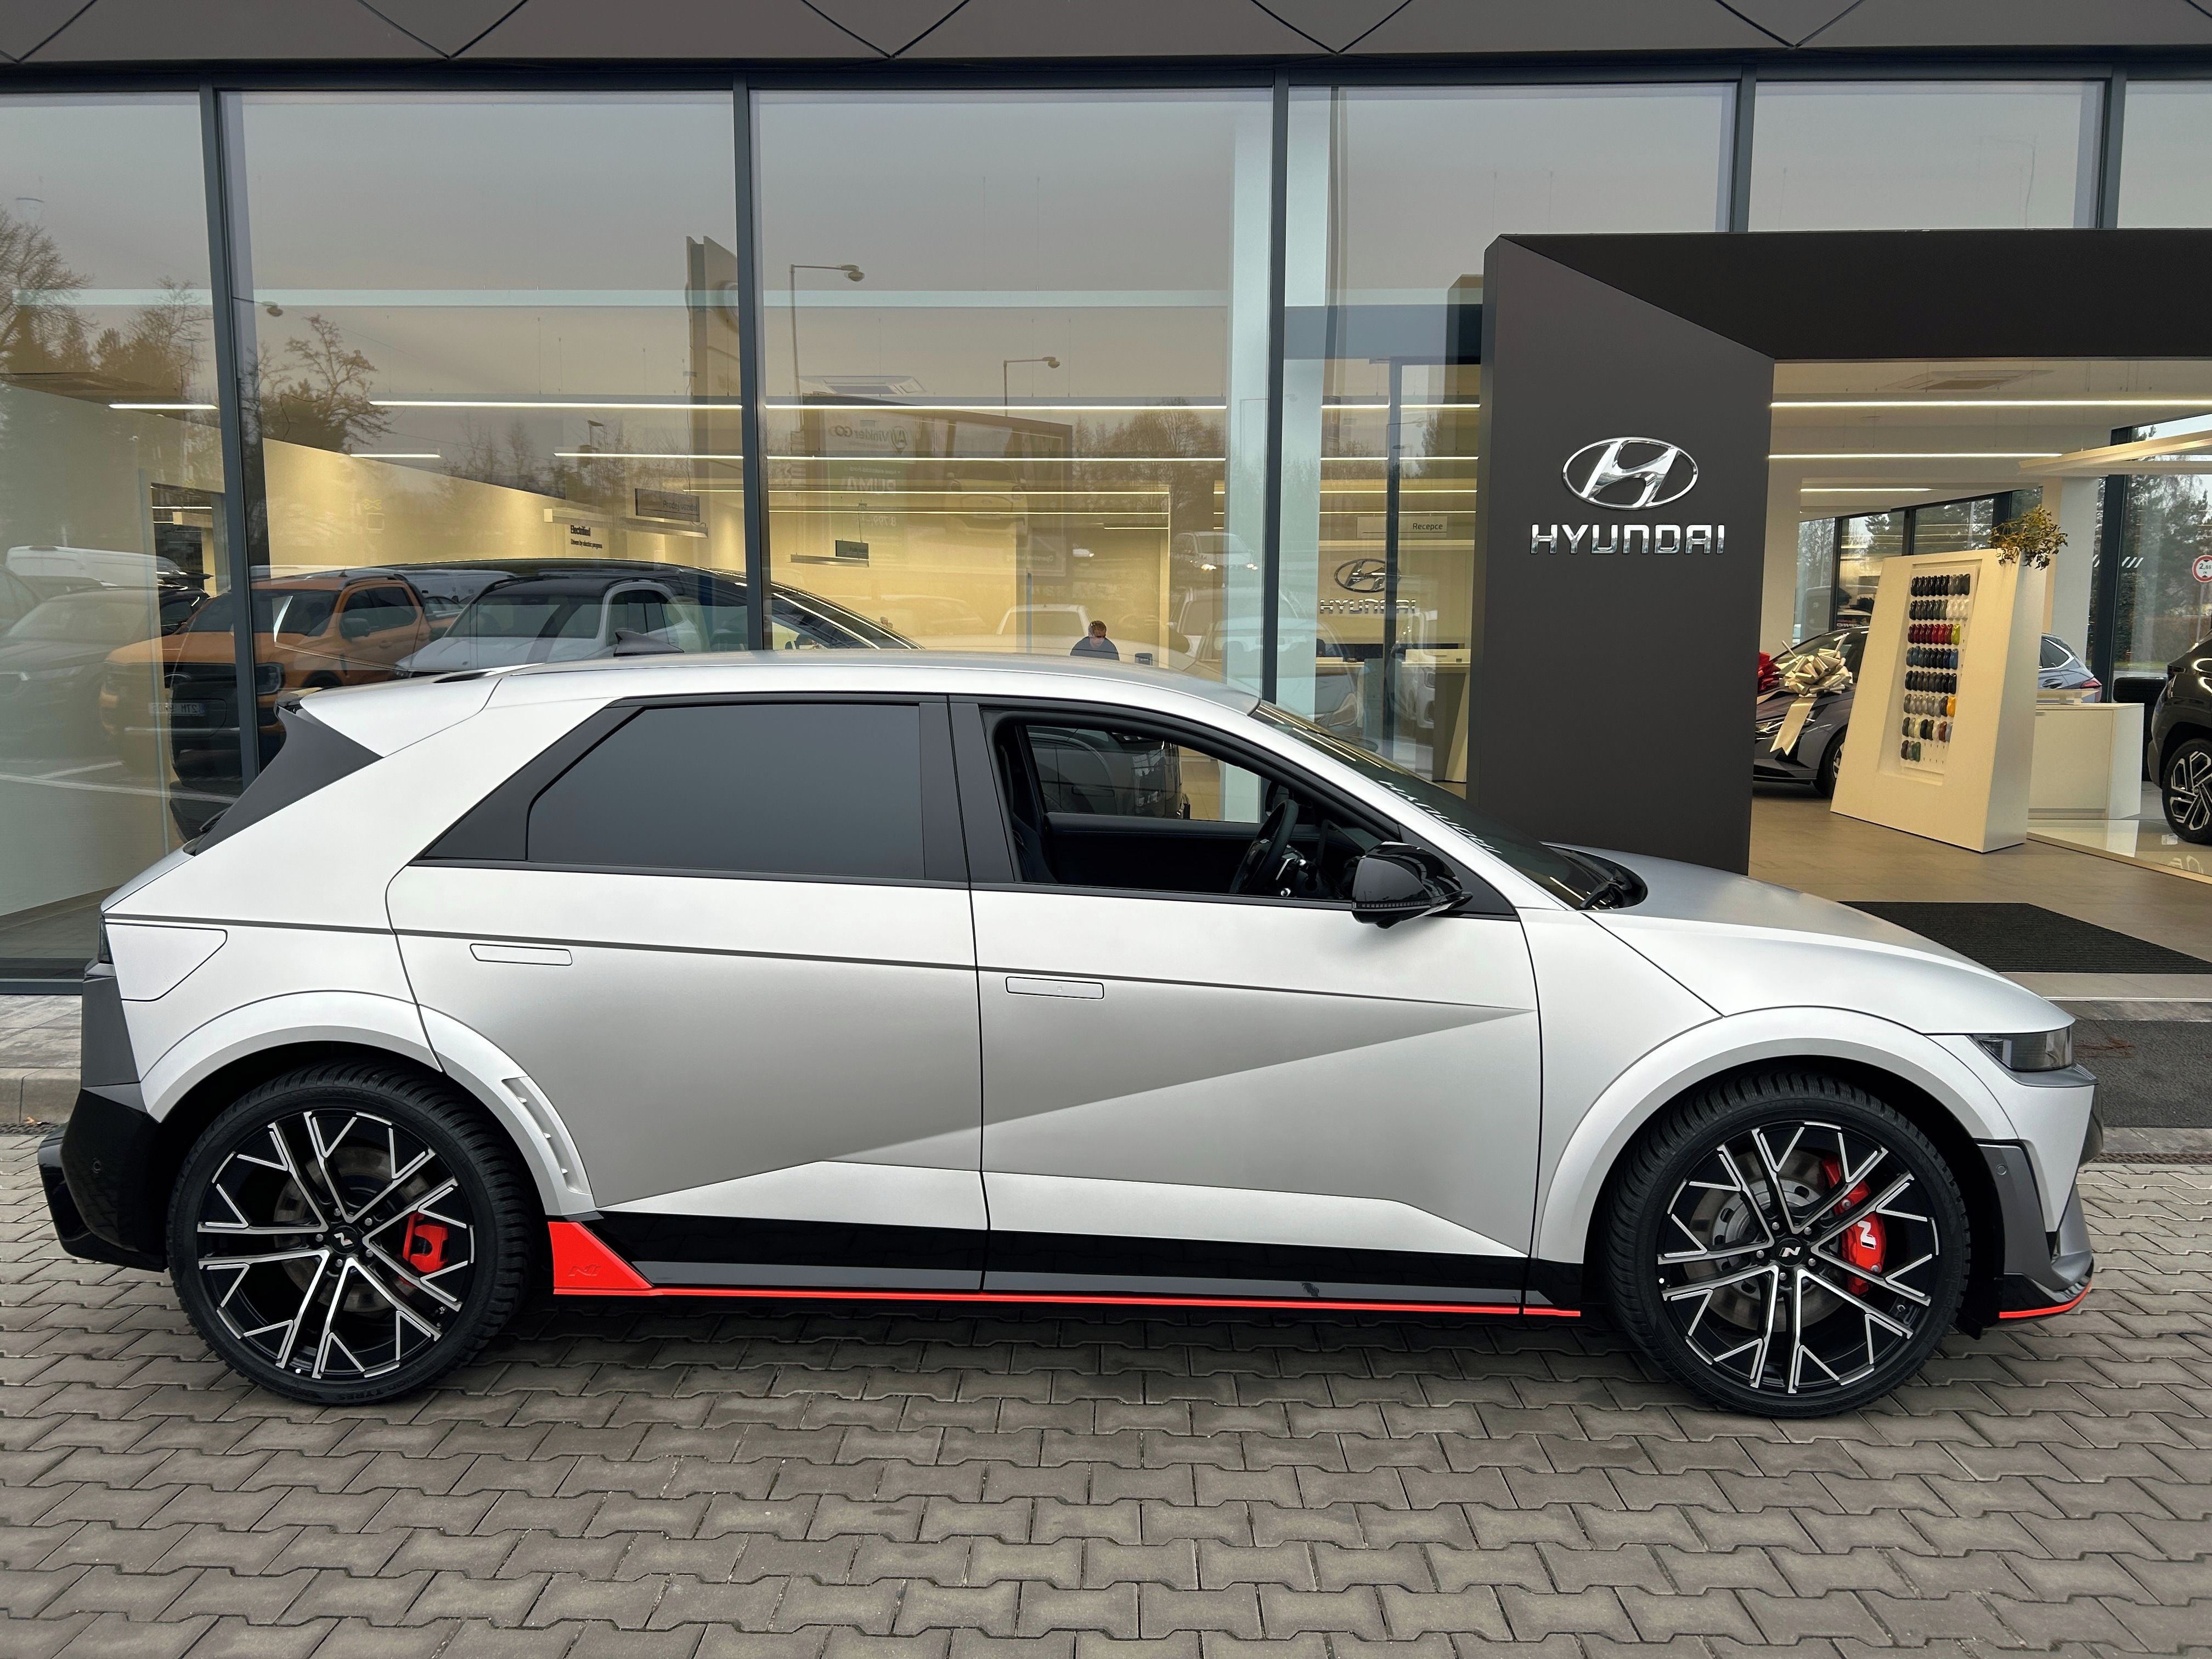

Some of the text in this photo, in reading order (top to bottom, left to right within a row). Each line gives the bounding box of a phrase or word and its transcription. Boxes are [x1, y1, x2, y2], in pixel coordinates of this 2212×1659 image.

[663, 500, 680, 511] Prodej
[1412, 522, 1443, 531] Recepce
[1530, 524, 1725, 555] HYUNDAI
